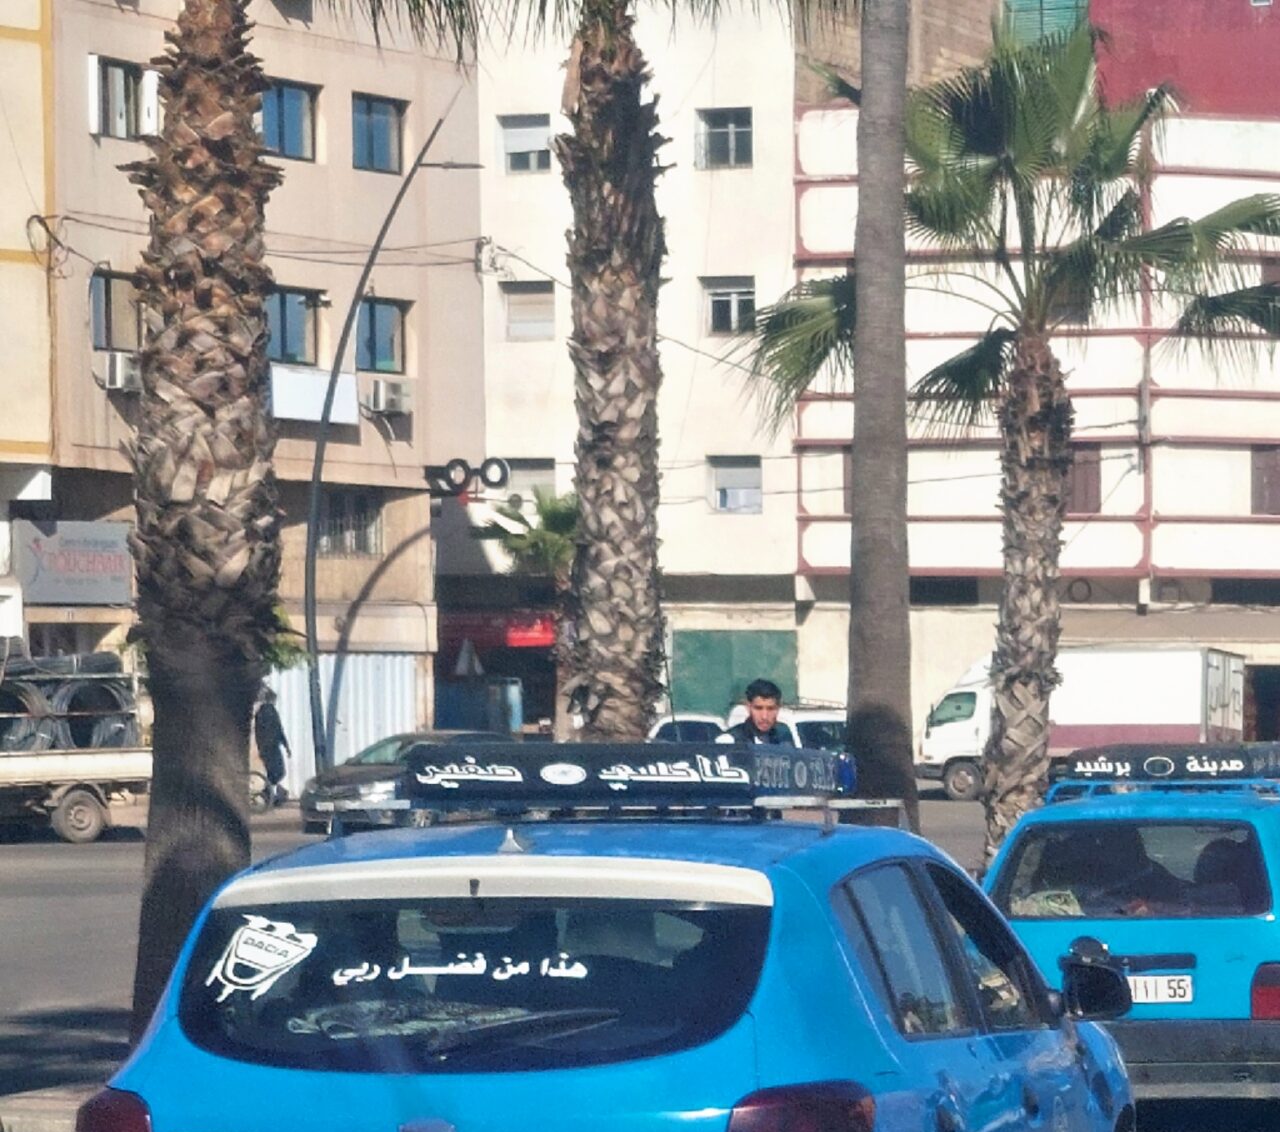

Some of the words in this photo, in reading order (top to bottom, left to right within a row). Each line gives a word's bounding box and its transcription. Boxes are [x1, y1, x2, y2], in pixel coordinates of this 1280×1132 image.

[1074, 756, 1132, 777] برشيد
[1185, 756, 1245, 776] مدينة
[1167, 978, 1187, 999] 55
